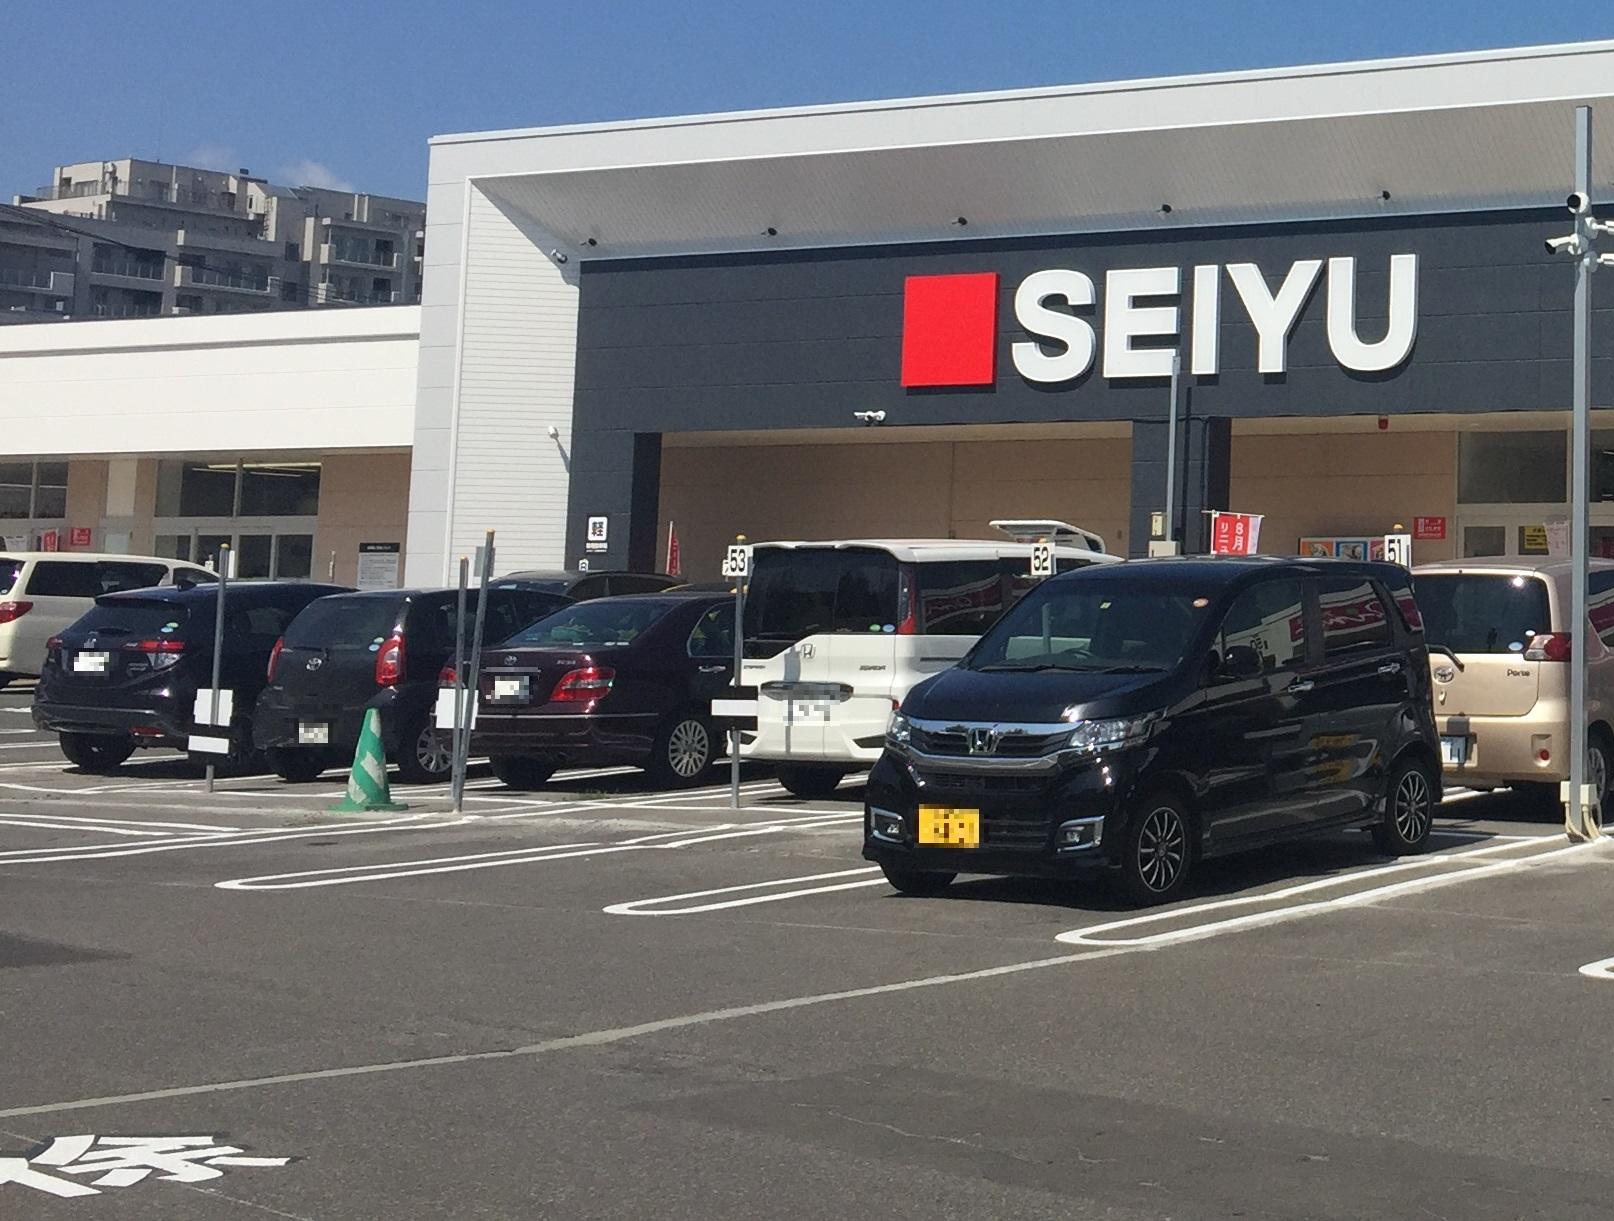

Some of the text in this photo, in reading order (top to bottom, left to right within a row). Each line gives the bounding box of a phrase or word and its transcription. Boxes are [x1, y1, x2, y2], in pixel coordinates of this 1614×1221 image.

[1012, 253, 1419, 383] SEIYU
[730, 548, 746, 573] 53
[1033, 546, 1049, 571] 52
[1387, 538, 1402, 562] 51
